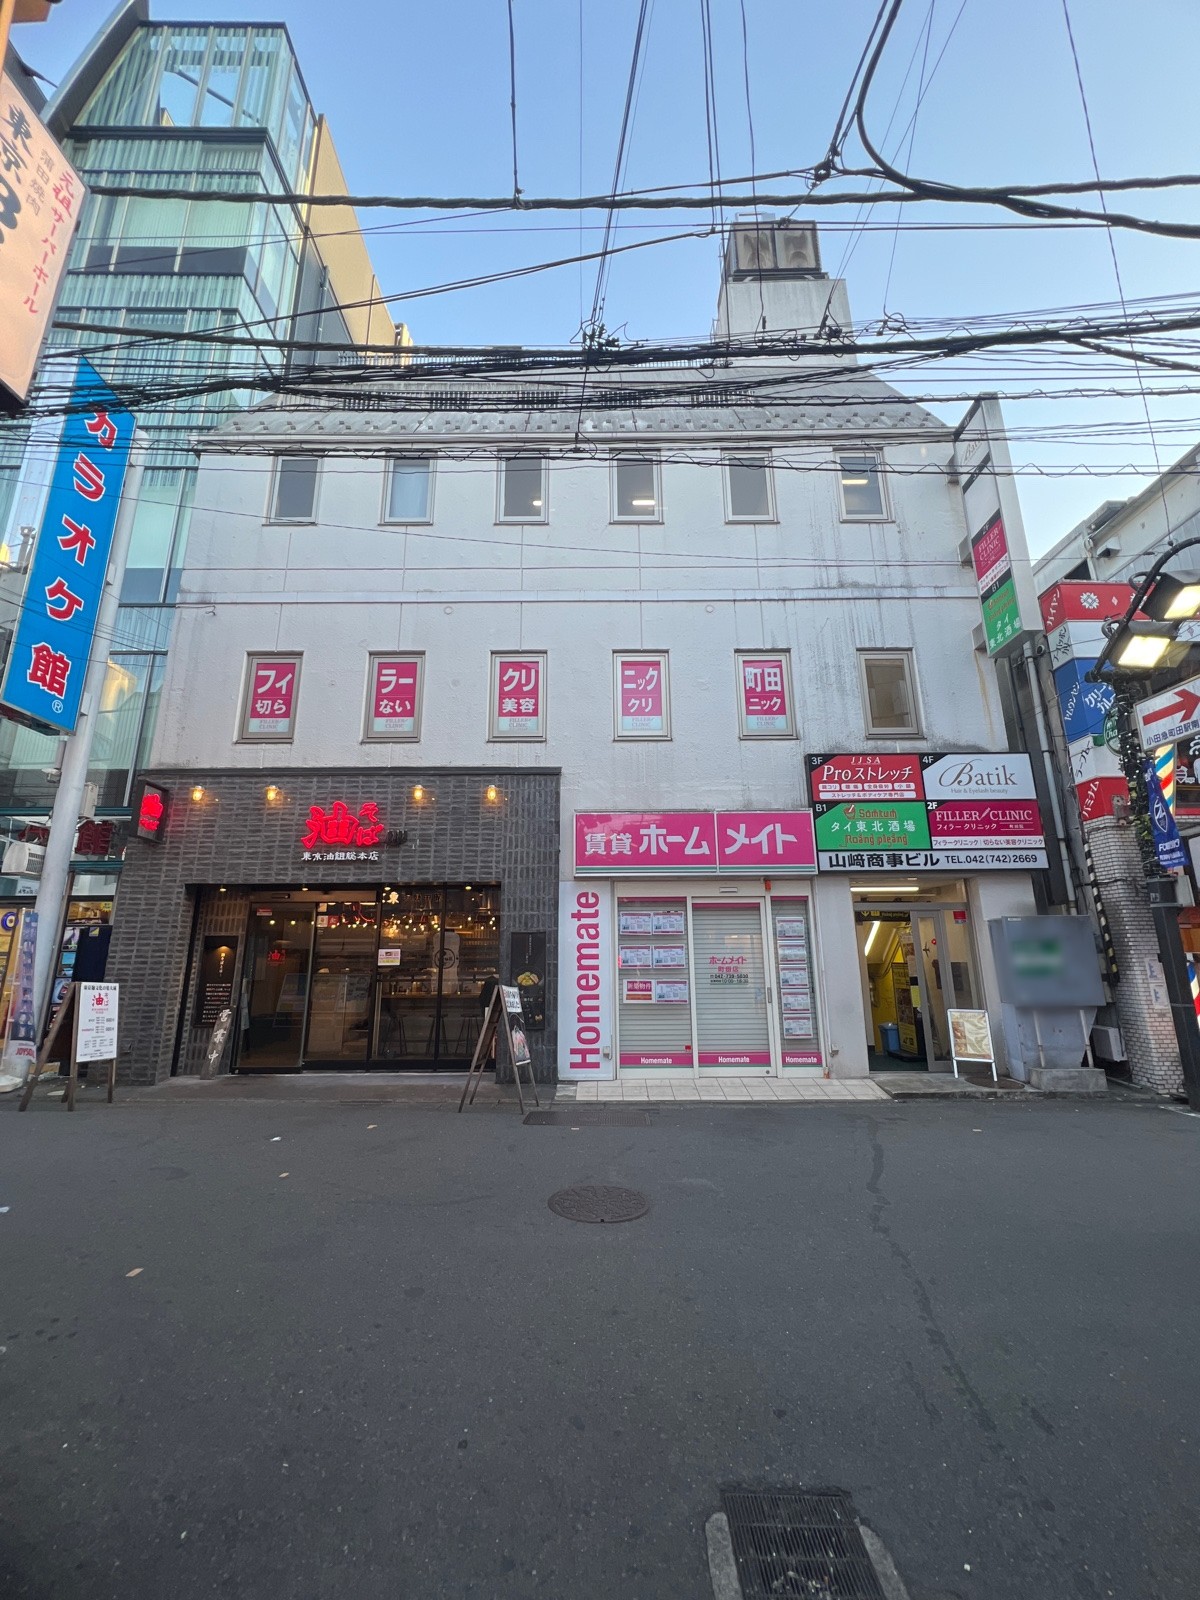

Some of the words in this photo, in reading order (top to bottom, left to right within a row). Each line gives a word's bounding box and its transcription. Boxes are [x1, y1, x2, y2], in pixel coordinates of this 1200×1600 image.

[978, 528, 999, 553] FILLER
[979, 535, 1001, 561] CLINIC
[27, 398, 118, 699] カラオケ館
[257, 670, 293, 694] フィ
[379, 669, 414, 694] ラー
[503, 668, 536, 692] クリ
[624, 667, 658, 691] ニック
[745, 668, 782, 692] 町田
[256, 700, 287, 715] 切ら
[379, 700, 411, 714] ない
[502, 698, 535, 713] 美容
[627, 698, 653, 713] クリ
[749, 698, 782, 712] ニック
[811, 757, 823, 765] 3F
[922, 755, 934, 764] 4F
[938, 759, 1018, 787] Batik
[815, 804, 827, 812] B1
[927, 802, 938, 810] 2F
[935, 810, 980, 821] FILLER
[989, 810, 1033, 821] CLINIC
[831, 820, 916, 832] タイ東北酒場
[964, 823, 997, 831] クリニック
[983, 838, 1043, 846] 切らない美容クリニック
[945, 855, 1038, 864] TEL.042(742)2669
[709, 956, 747, 965] ホームメイト
[570, 891, 601, 1069] Homemate
[208, 1008, 232, 1064] 営業中
[640, 1056, 673, 1064] Homemate
